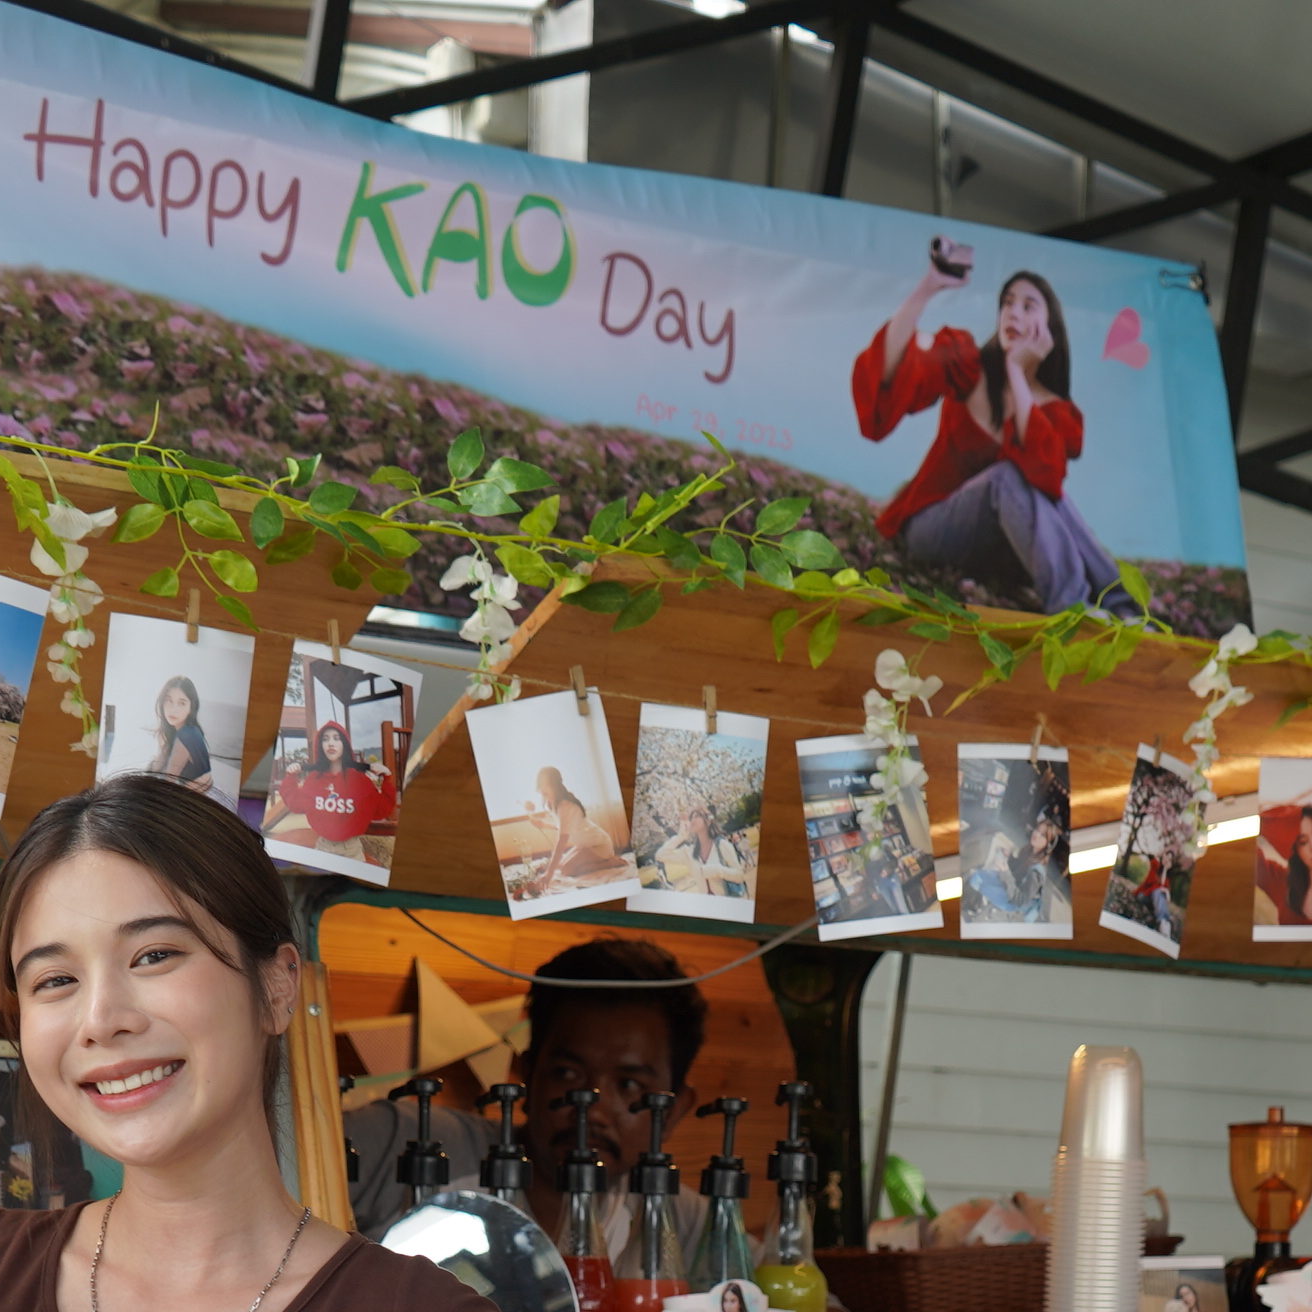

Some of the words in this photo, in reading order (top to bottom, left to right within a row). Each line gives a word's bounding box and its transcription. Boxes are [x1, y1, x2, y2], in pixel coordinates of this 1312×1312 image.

[23, 97, 300, 266] Happy
[336, 160, 578, 308] KAO
[599, 250, 736, 385] Day
[636, 393, 680, 427] Apr
[691, 409, 726, 441] 29,
[736, 418, 794, 450] 2023
[315, 796, 355, 813] BOSS
